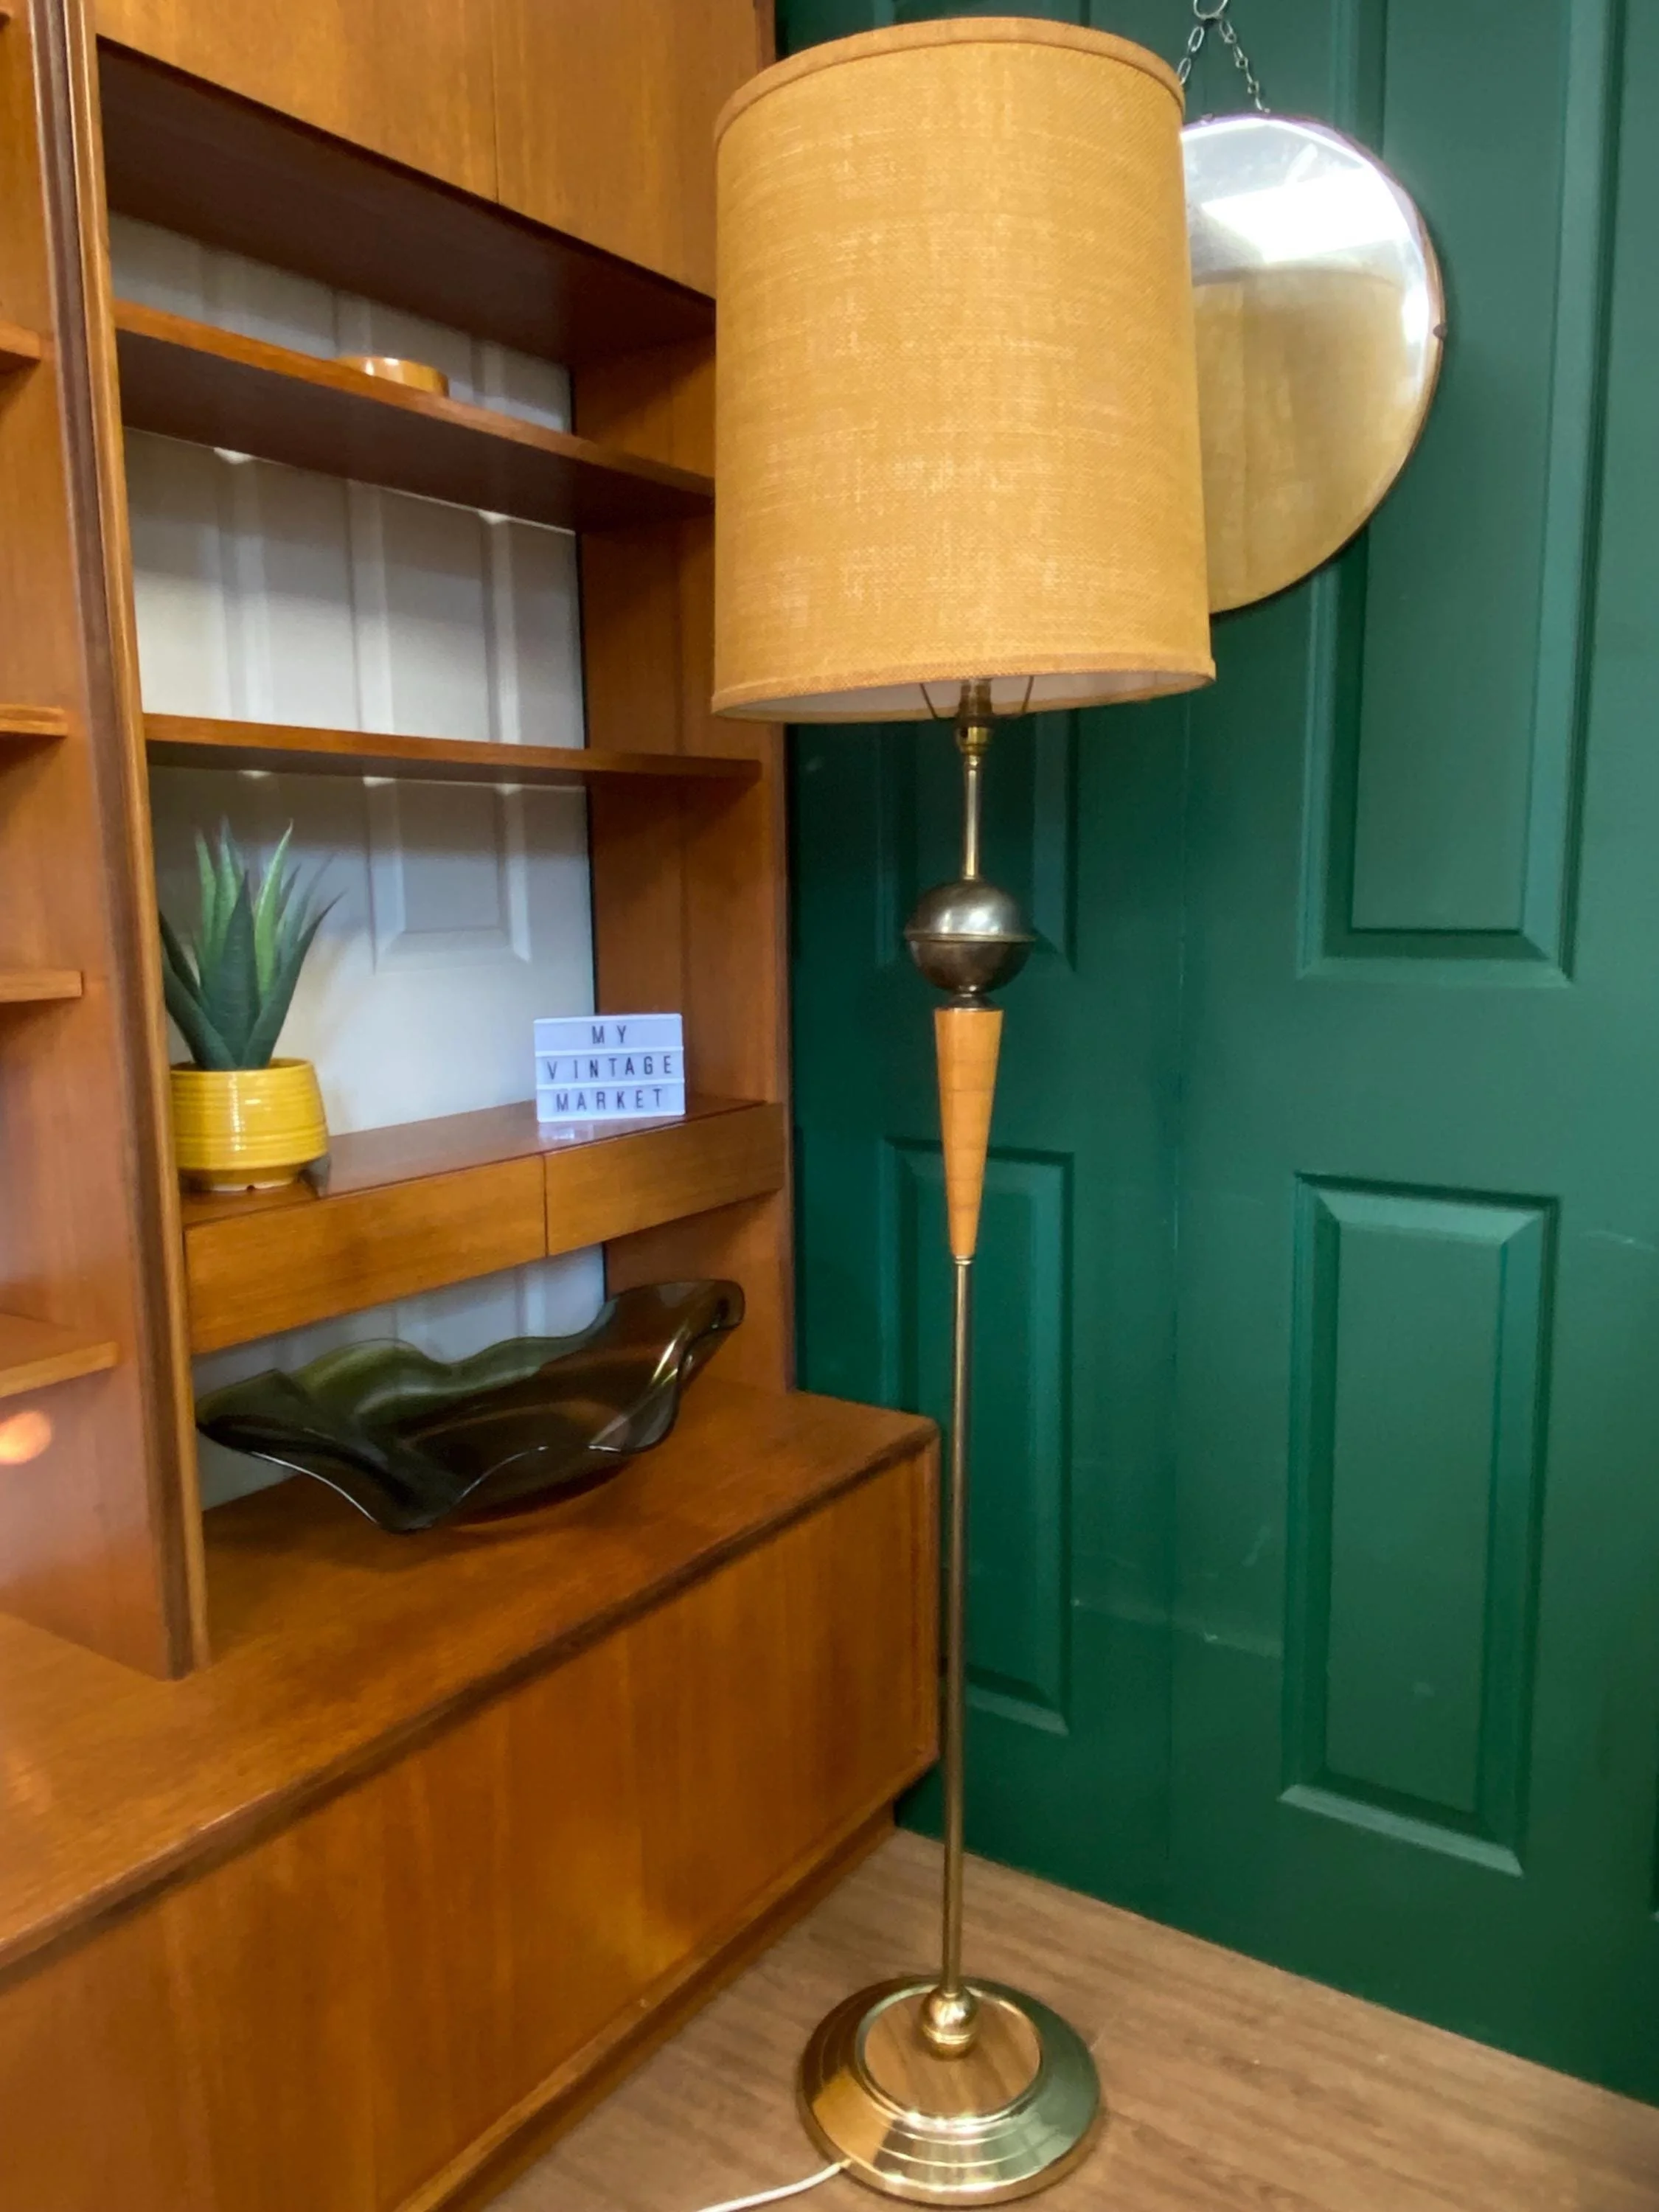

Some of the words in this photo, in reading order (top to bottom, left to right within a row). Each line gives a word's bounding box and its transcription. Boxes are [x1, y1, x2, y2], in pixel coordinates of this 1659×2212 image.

[592, 1026, 627, 1044] MY
[547, 1055, 672, 1080] VINTAGE
[557, 1088, 662, 1112] MARKET
